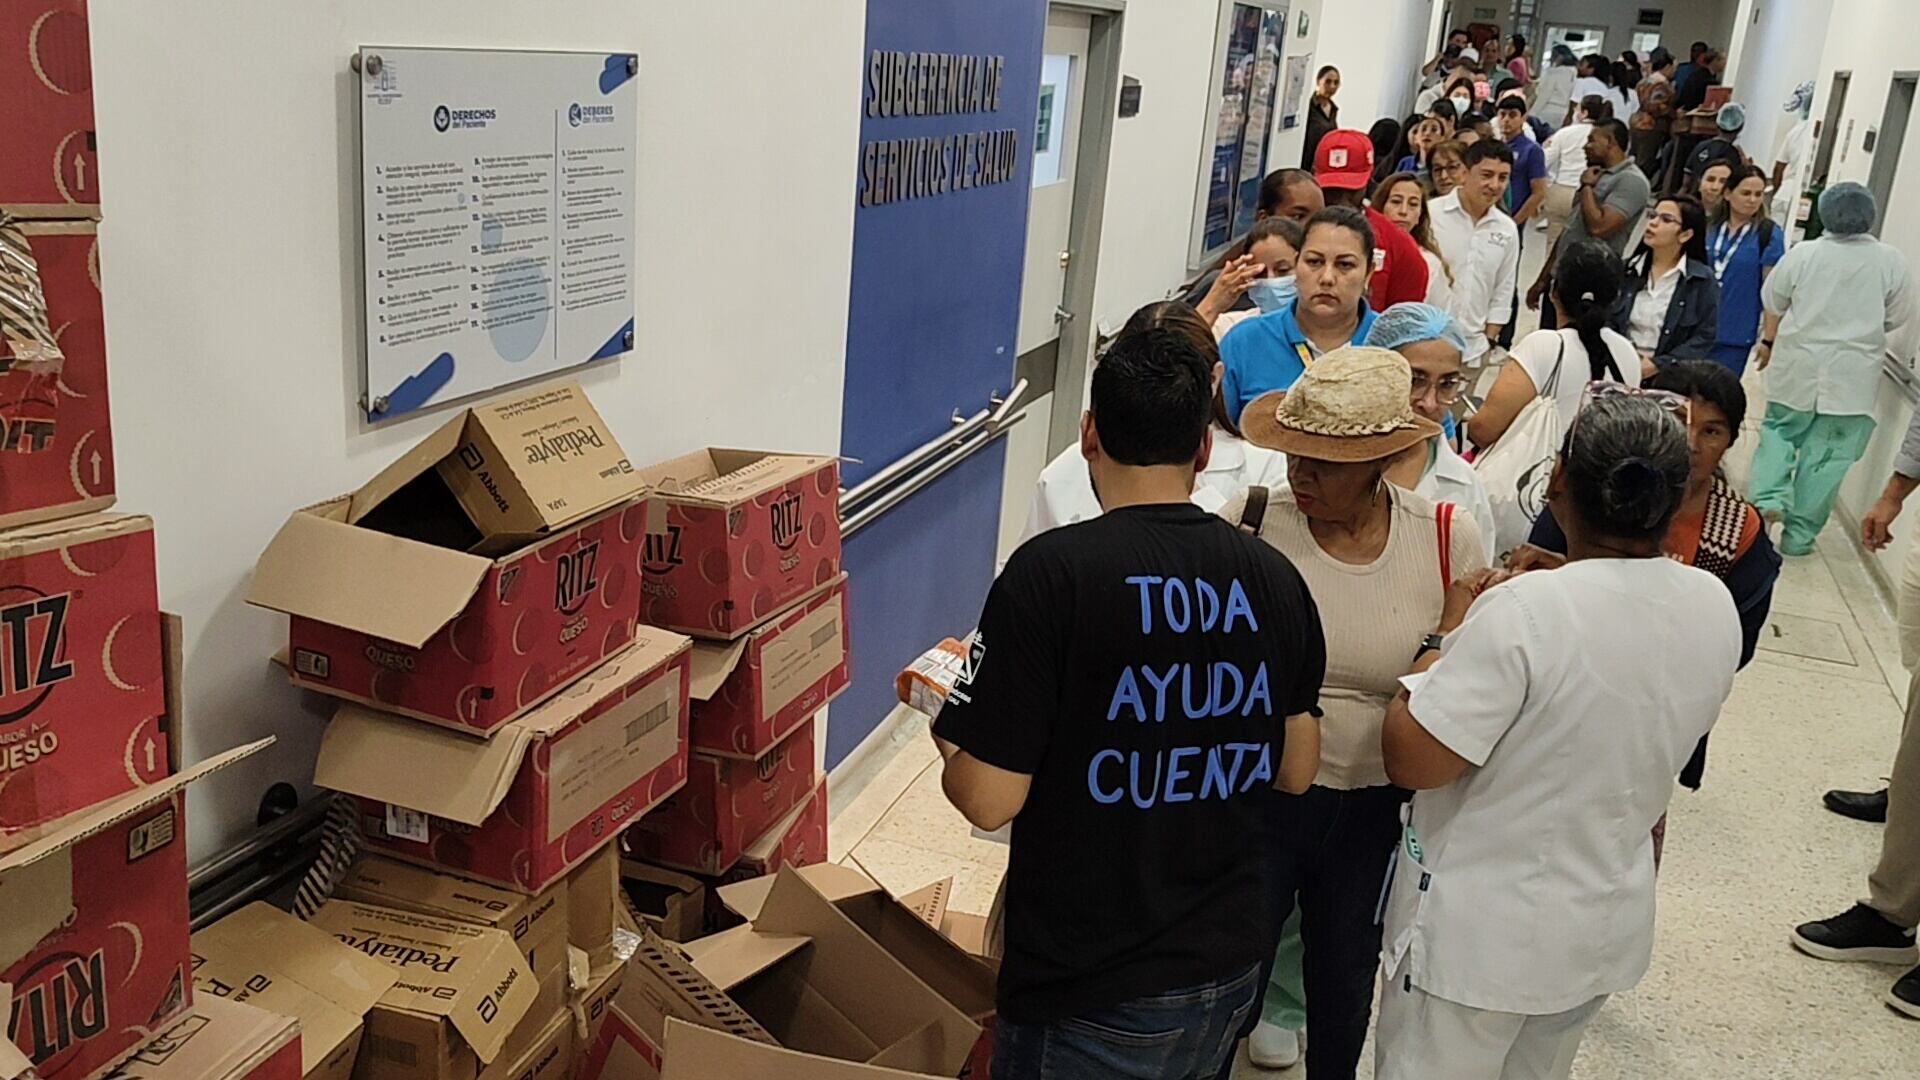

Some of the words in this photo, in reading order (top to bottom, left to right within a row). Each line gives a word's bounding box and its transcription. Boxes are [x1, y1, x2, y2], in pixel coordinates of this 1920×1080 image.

[866, 49, 981, 118] SUBGERENCIA
[981, 55, 1004, 112] DE
[452, 109, 496, 120] DERECHOS
[583, 106, 613, 115] DEBERES
[860, 136, 950, 208] SERVICIOS
[951, 133, 977, 192] DE
[973, 128, 1018, 188] SALUD
[524, 425, 605, 465] Pedialyte
[477, 469, 510, 514] Abbott
[547, 498, 567, 512] TAPA
[771, 493, 803, 546] RITZ
[555, 541, 599, 609] RITZ
[1125, 575, 1258, 634] TODA
[559, 616, 588, 645] QUESO
[366, 645, 416, 671] QUESO
[1106, 660, 1273, 722] AYUDA
[1087, 742, 1273, 809] CUENTA
[493, 967, 519, 1002] Abbott
